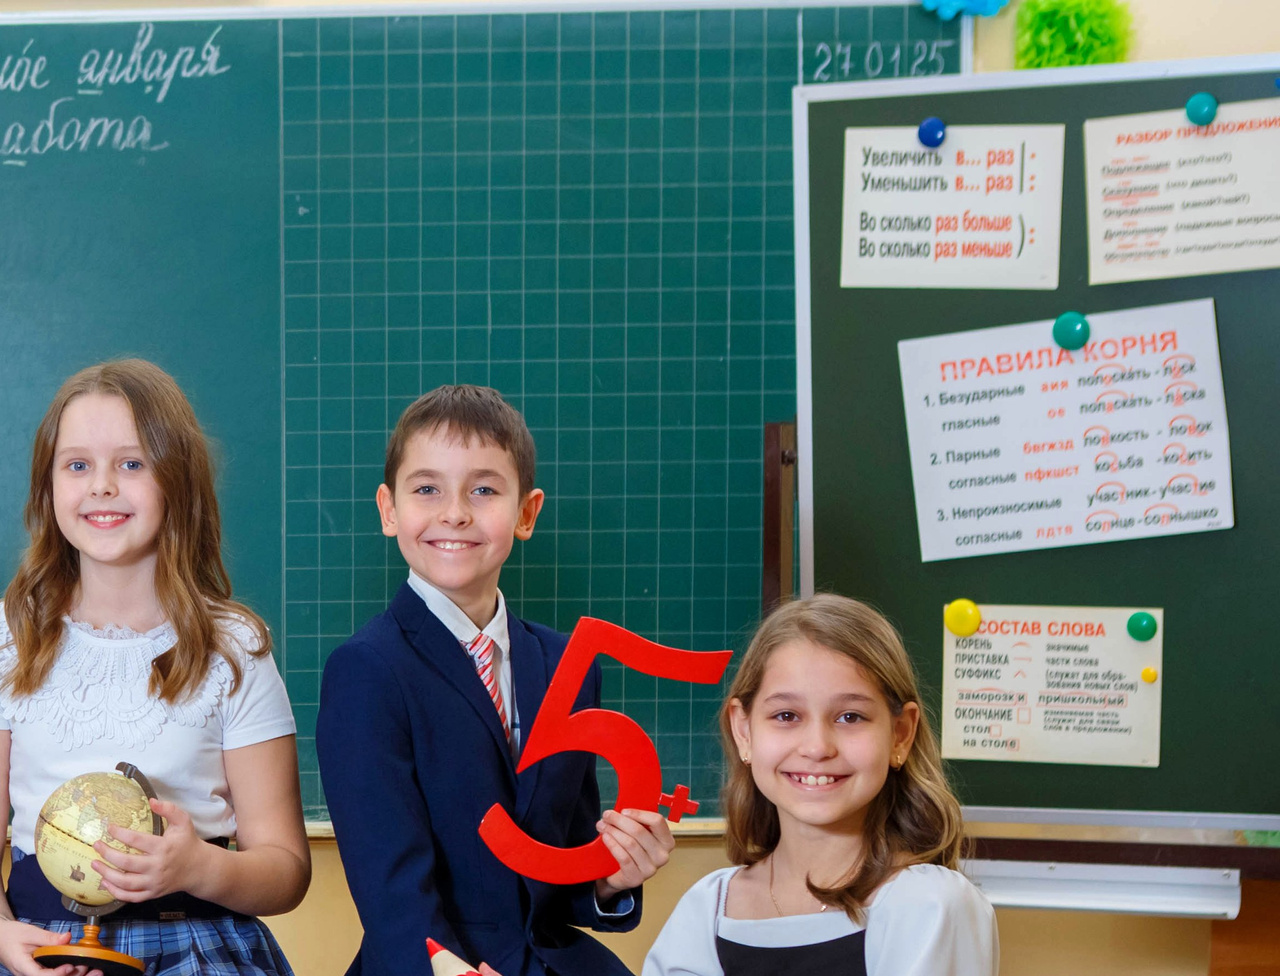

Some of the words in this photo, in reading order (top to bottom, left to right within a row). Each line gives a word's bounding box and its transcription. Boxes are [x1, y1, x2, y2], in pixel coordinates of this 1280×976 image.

[1116, 128, 1172, 145] РАЗБОР
[1176, 116, 1280, 140] ПРЕДЛОЖЕНИ
[862, 147, 943, 167] Увеличить
[986, 150, 1015, 170] раз
[861, 172, 948, 192] Уменьшить
[985, 175, 1013, 195] раз
[859, 211, 876, 231] Во
[880, 214, 931, 232] сколько
[935, 215, 958, 236] раз
[962, 210, 1012, 232] больше
[859, 237, 875, 258] Во
[879, 240, 930, 258] сколько
[934, 241, 957, 262] раз
[961, 241, 1012, 258] меньше
[939, 347, 1074, 382] ПРАВИЛА
[1083, 331, 1178, 362] КОРНЯ
[923, 394, 935, 407] 1.
[939, 385, 1025, 406] Безударные
[942, 415, 1000, 432] гласные
[946, 448, 1001, 465] Парные
[948, 472, 1017, 489] согласные
[952, 498, 1062, 520] Непроизносимые
[955, 530, 1022, 546] согласные
[977, 620, 1041, 635] СОСТАВ
[1047, 621, 1106, 637] СЛОВА
[955, 638, 992, 650] КОРЕНЬ
[955, 653, 1010, 665] ПРИСТАВКА
[954, 668, 1002, 680] СУФФИКС
[954, 708, 1013, 720] ОКОНЧАНИЕ
[963, 724, 991, 734] стол
[963, 738, 976, 747] на
[981, 739, 1017, 748] столе
